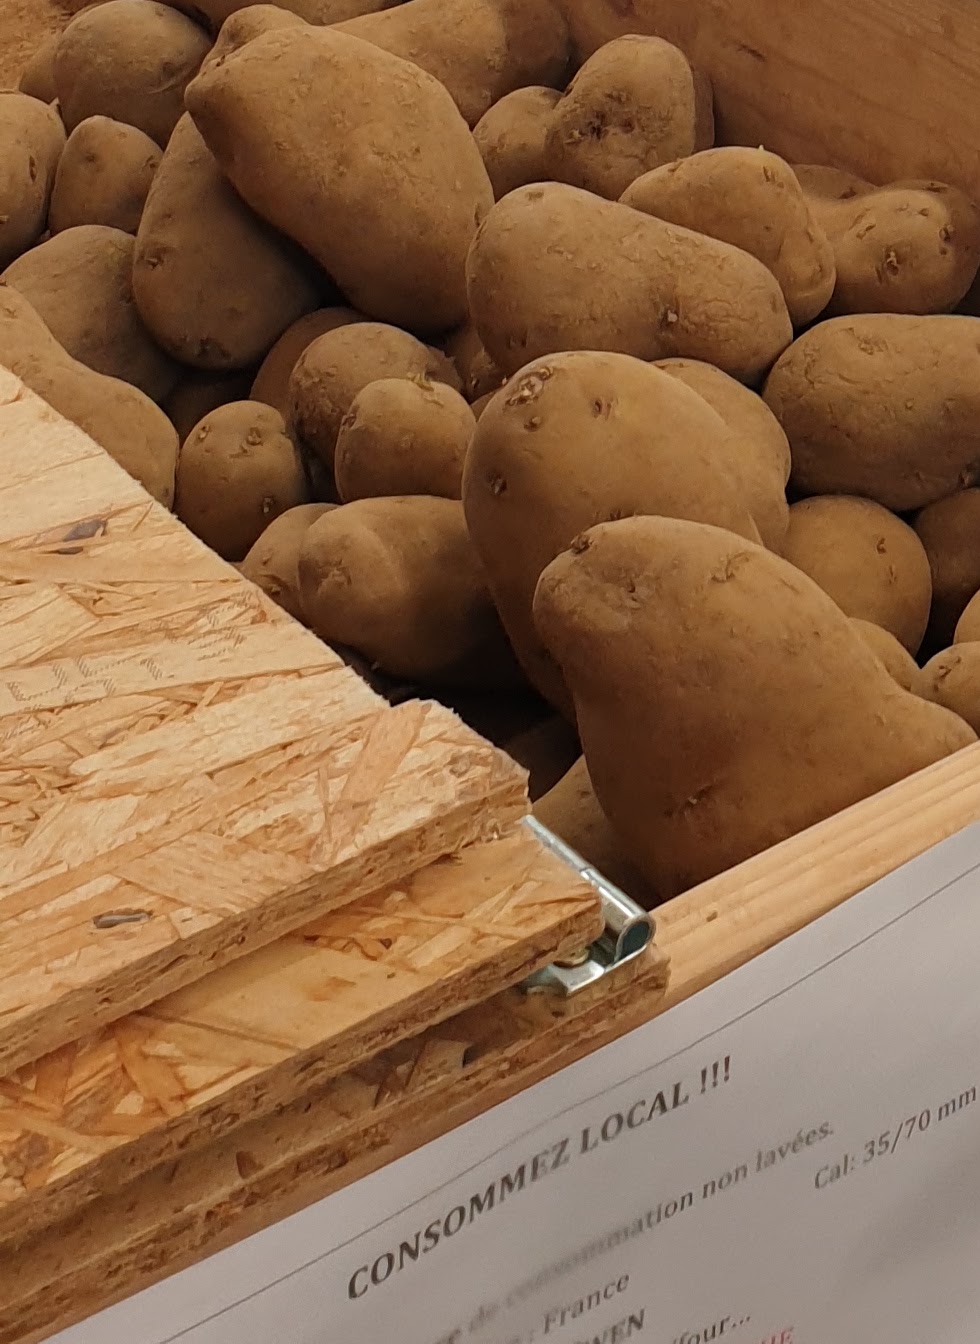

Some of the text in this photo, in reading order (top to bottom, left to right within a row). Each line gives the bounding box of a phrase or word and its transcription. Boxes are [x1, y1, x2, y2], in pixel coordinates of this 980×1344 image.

[346, 1055, 731, 1301] CONSOMMEZ LOCAL !!!
[814, 1085, 977, 1190] Cal: 35/70 mm
[504, 1190, 694, 1309] mmation
[701, 1163, 748, 1200] non
[755, 1120, 835, 1173] lavées.
[542, 1273, 631, 1335] France
